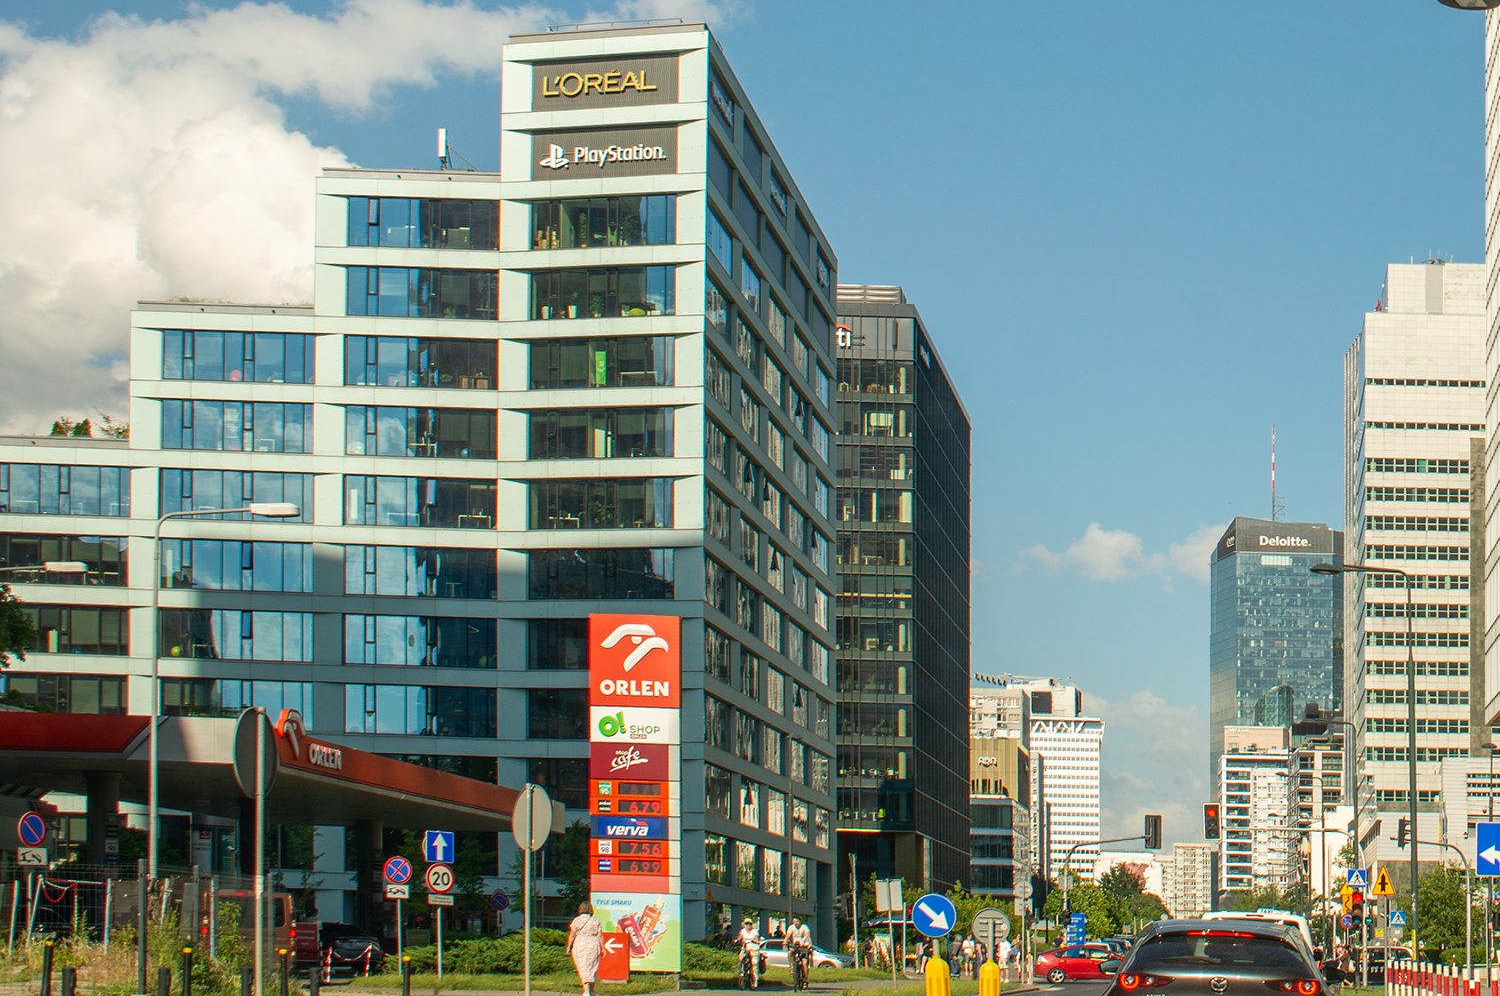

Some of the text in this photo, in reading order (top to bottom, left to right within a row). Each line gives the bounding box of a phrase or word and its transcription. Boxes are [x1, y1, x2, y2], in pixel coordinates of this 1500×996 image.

[542, 69, 658, 96] L'ORÉAL
[836, 327, 852, 347] ti
[1259, 535, 1312, 547] Deloitte.
[600, 679, 669, 697] ORLEN
[629, 724, 661, 734] SHOP
[309, 743, 342, 770] ORLEN
[629, 801, 661, 813] 6.79
[606, 825, 650, 836] verva
[630, 842, 661, 855] 7.56
[629, 861, 661, 873] 6.99
[432, 872, 450, 886] 20
